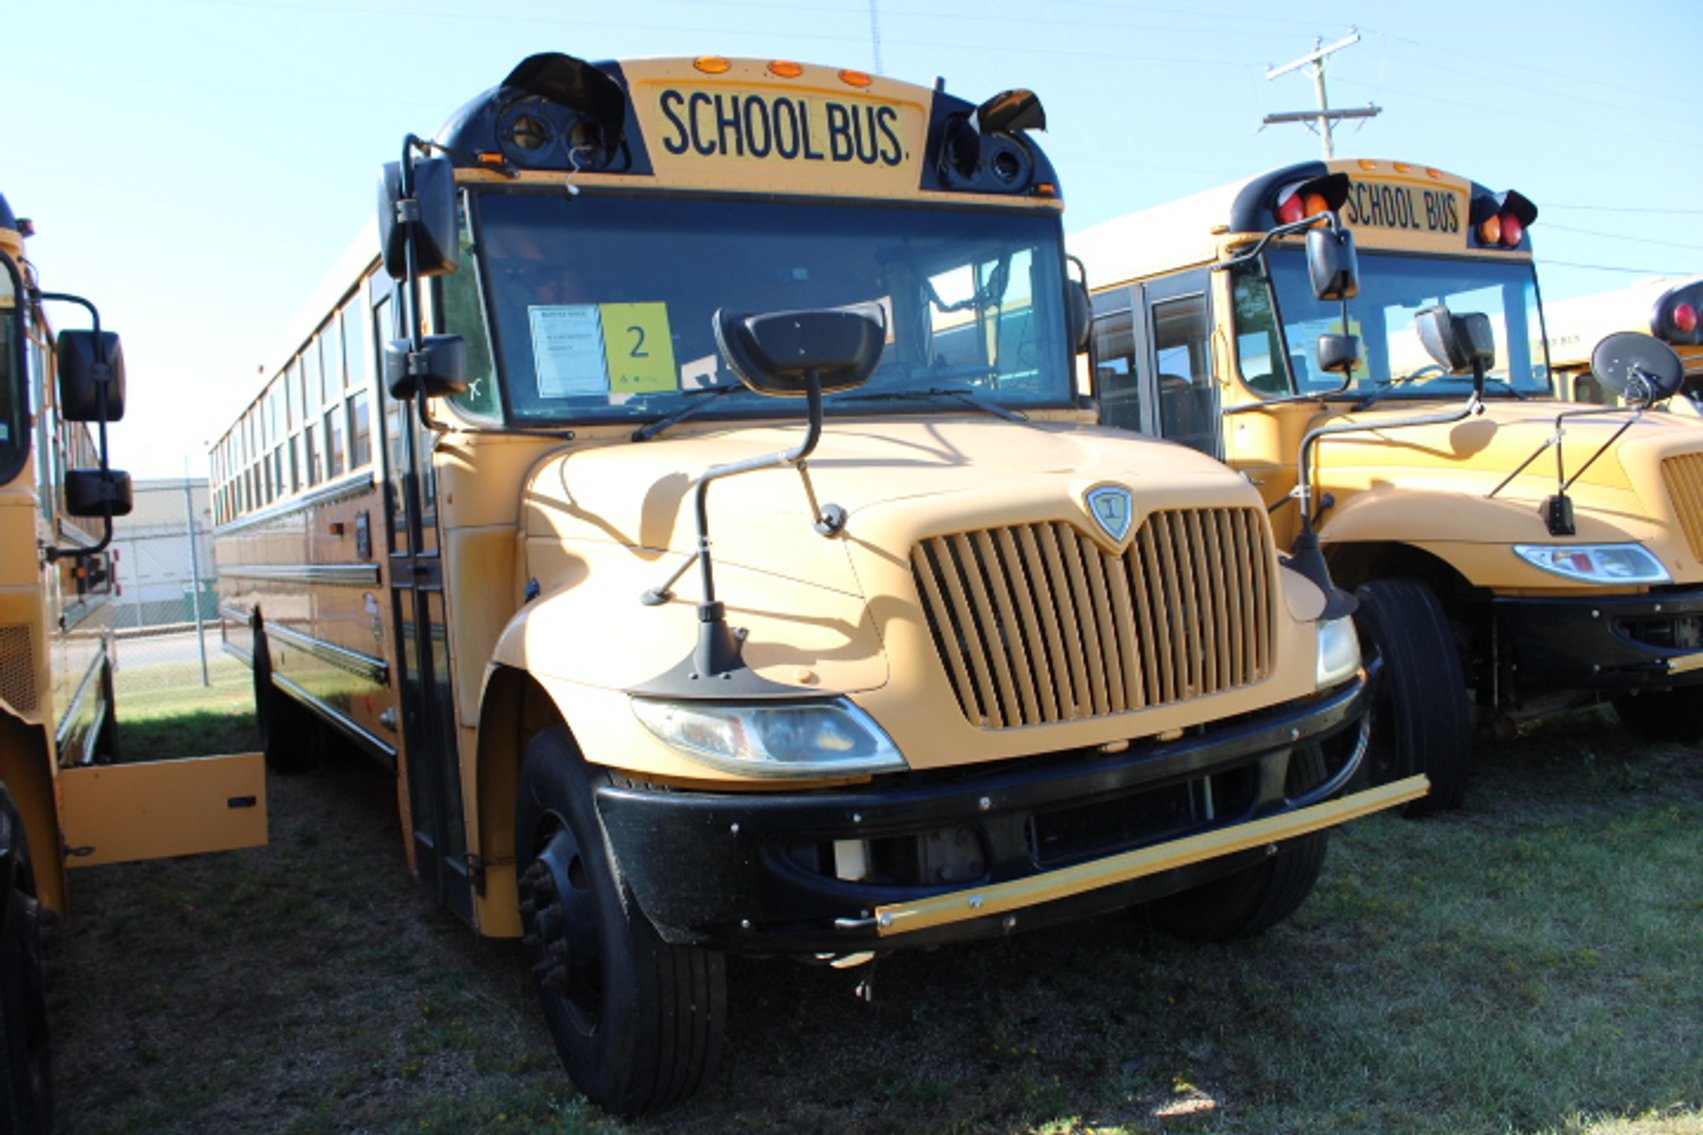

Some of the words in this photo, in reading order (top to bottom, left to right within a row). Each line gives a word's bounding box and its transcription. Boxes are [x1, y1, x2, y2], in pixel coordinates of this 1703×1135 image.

[659, 89, 824, 160] SCHOOL
[1347, 181, 1420, 229] SCHOOL
[1423, 190, 1459, 233] BUS
[626, 325, 649, 358] 2
